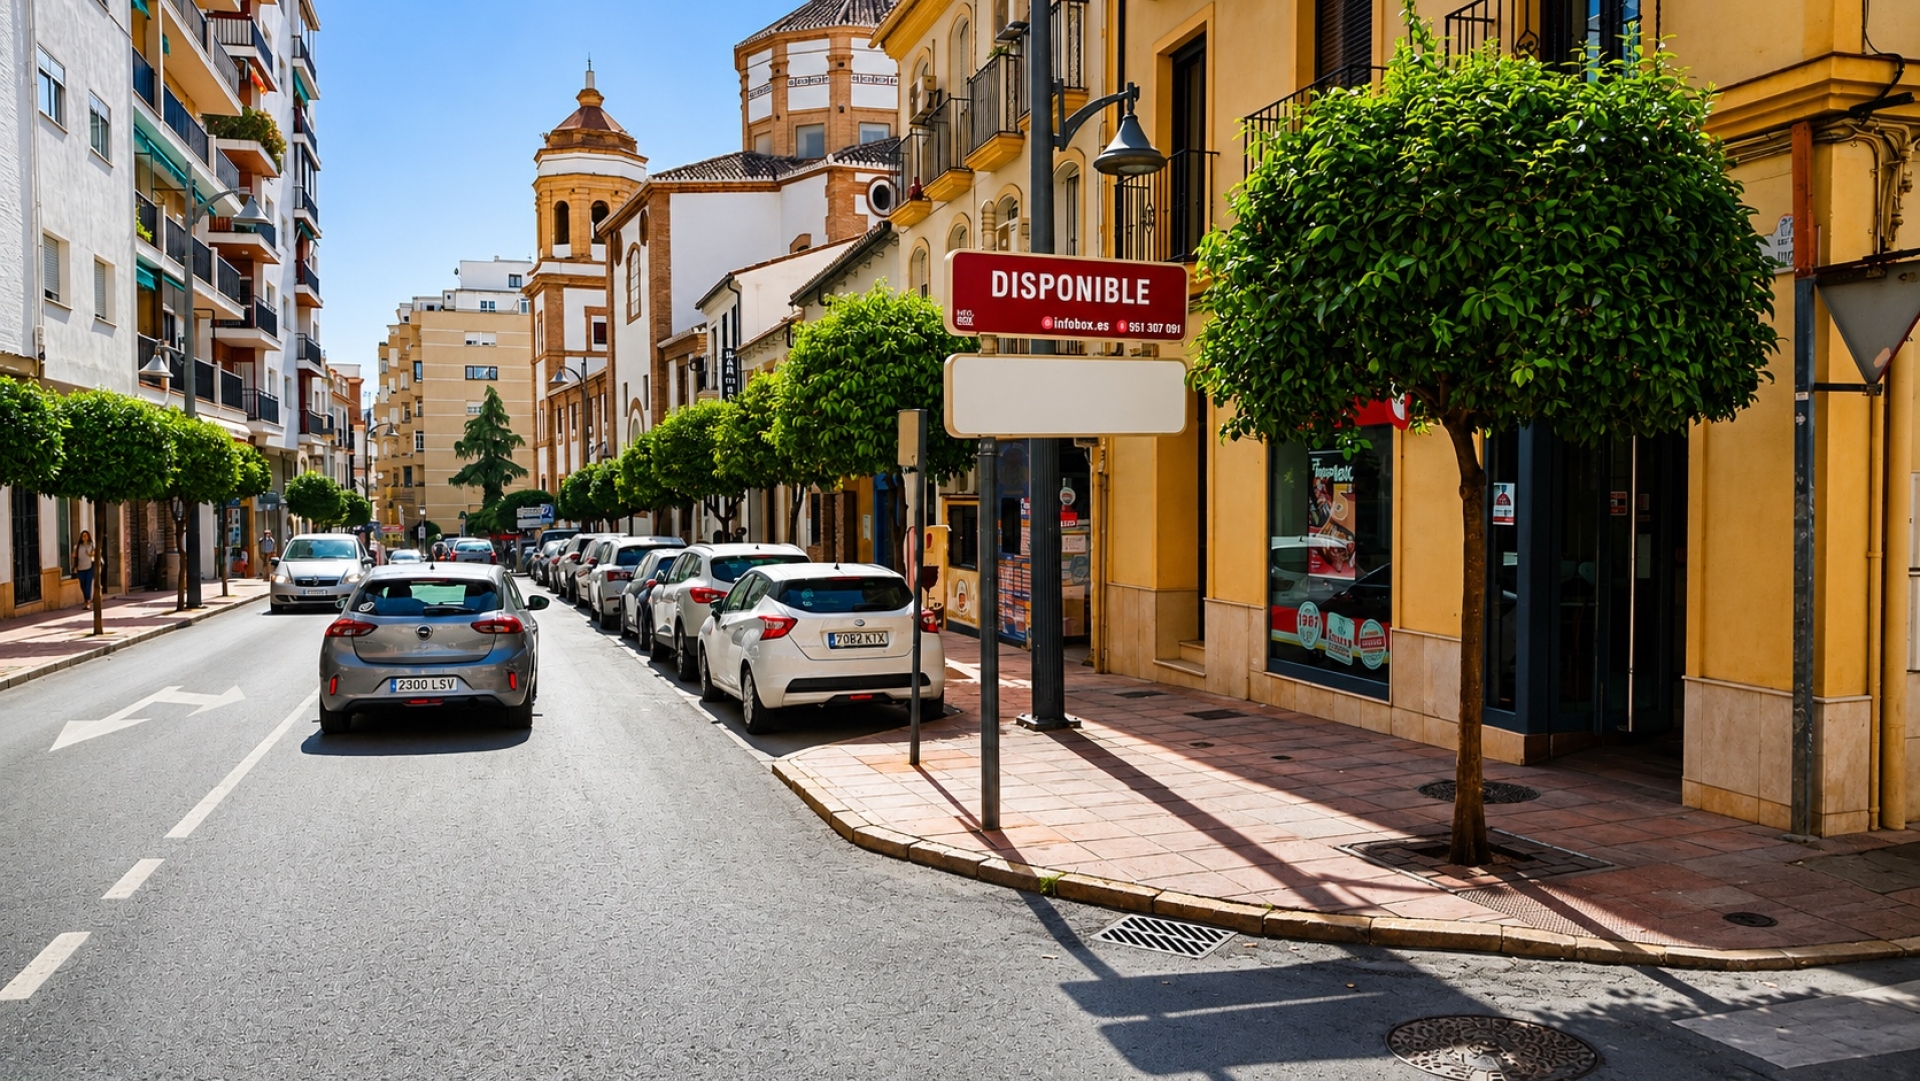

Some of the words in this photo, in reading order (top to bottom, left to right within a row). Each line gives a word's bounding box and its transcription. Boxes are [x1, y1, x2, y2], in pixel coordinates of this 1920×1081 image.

[992, 270, 1150, 305] DISPONIBLE
[1054, 317, 1109, 331] infobox.es
[1147, 323, 1163, 333] 307
[1166, 324, 1181, 334] 091
[398, 679, 428, 690] 2300
[432, 678, 455, 690] LSV
